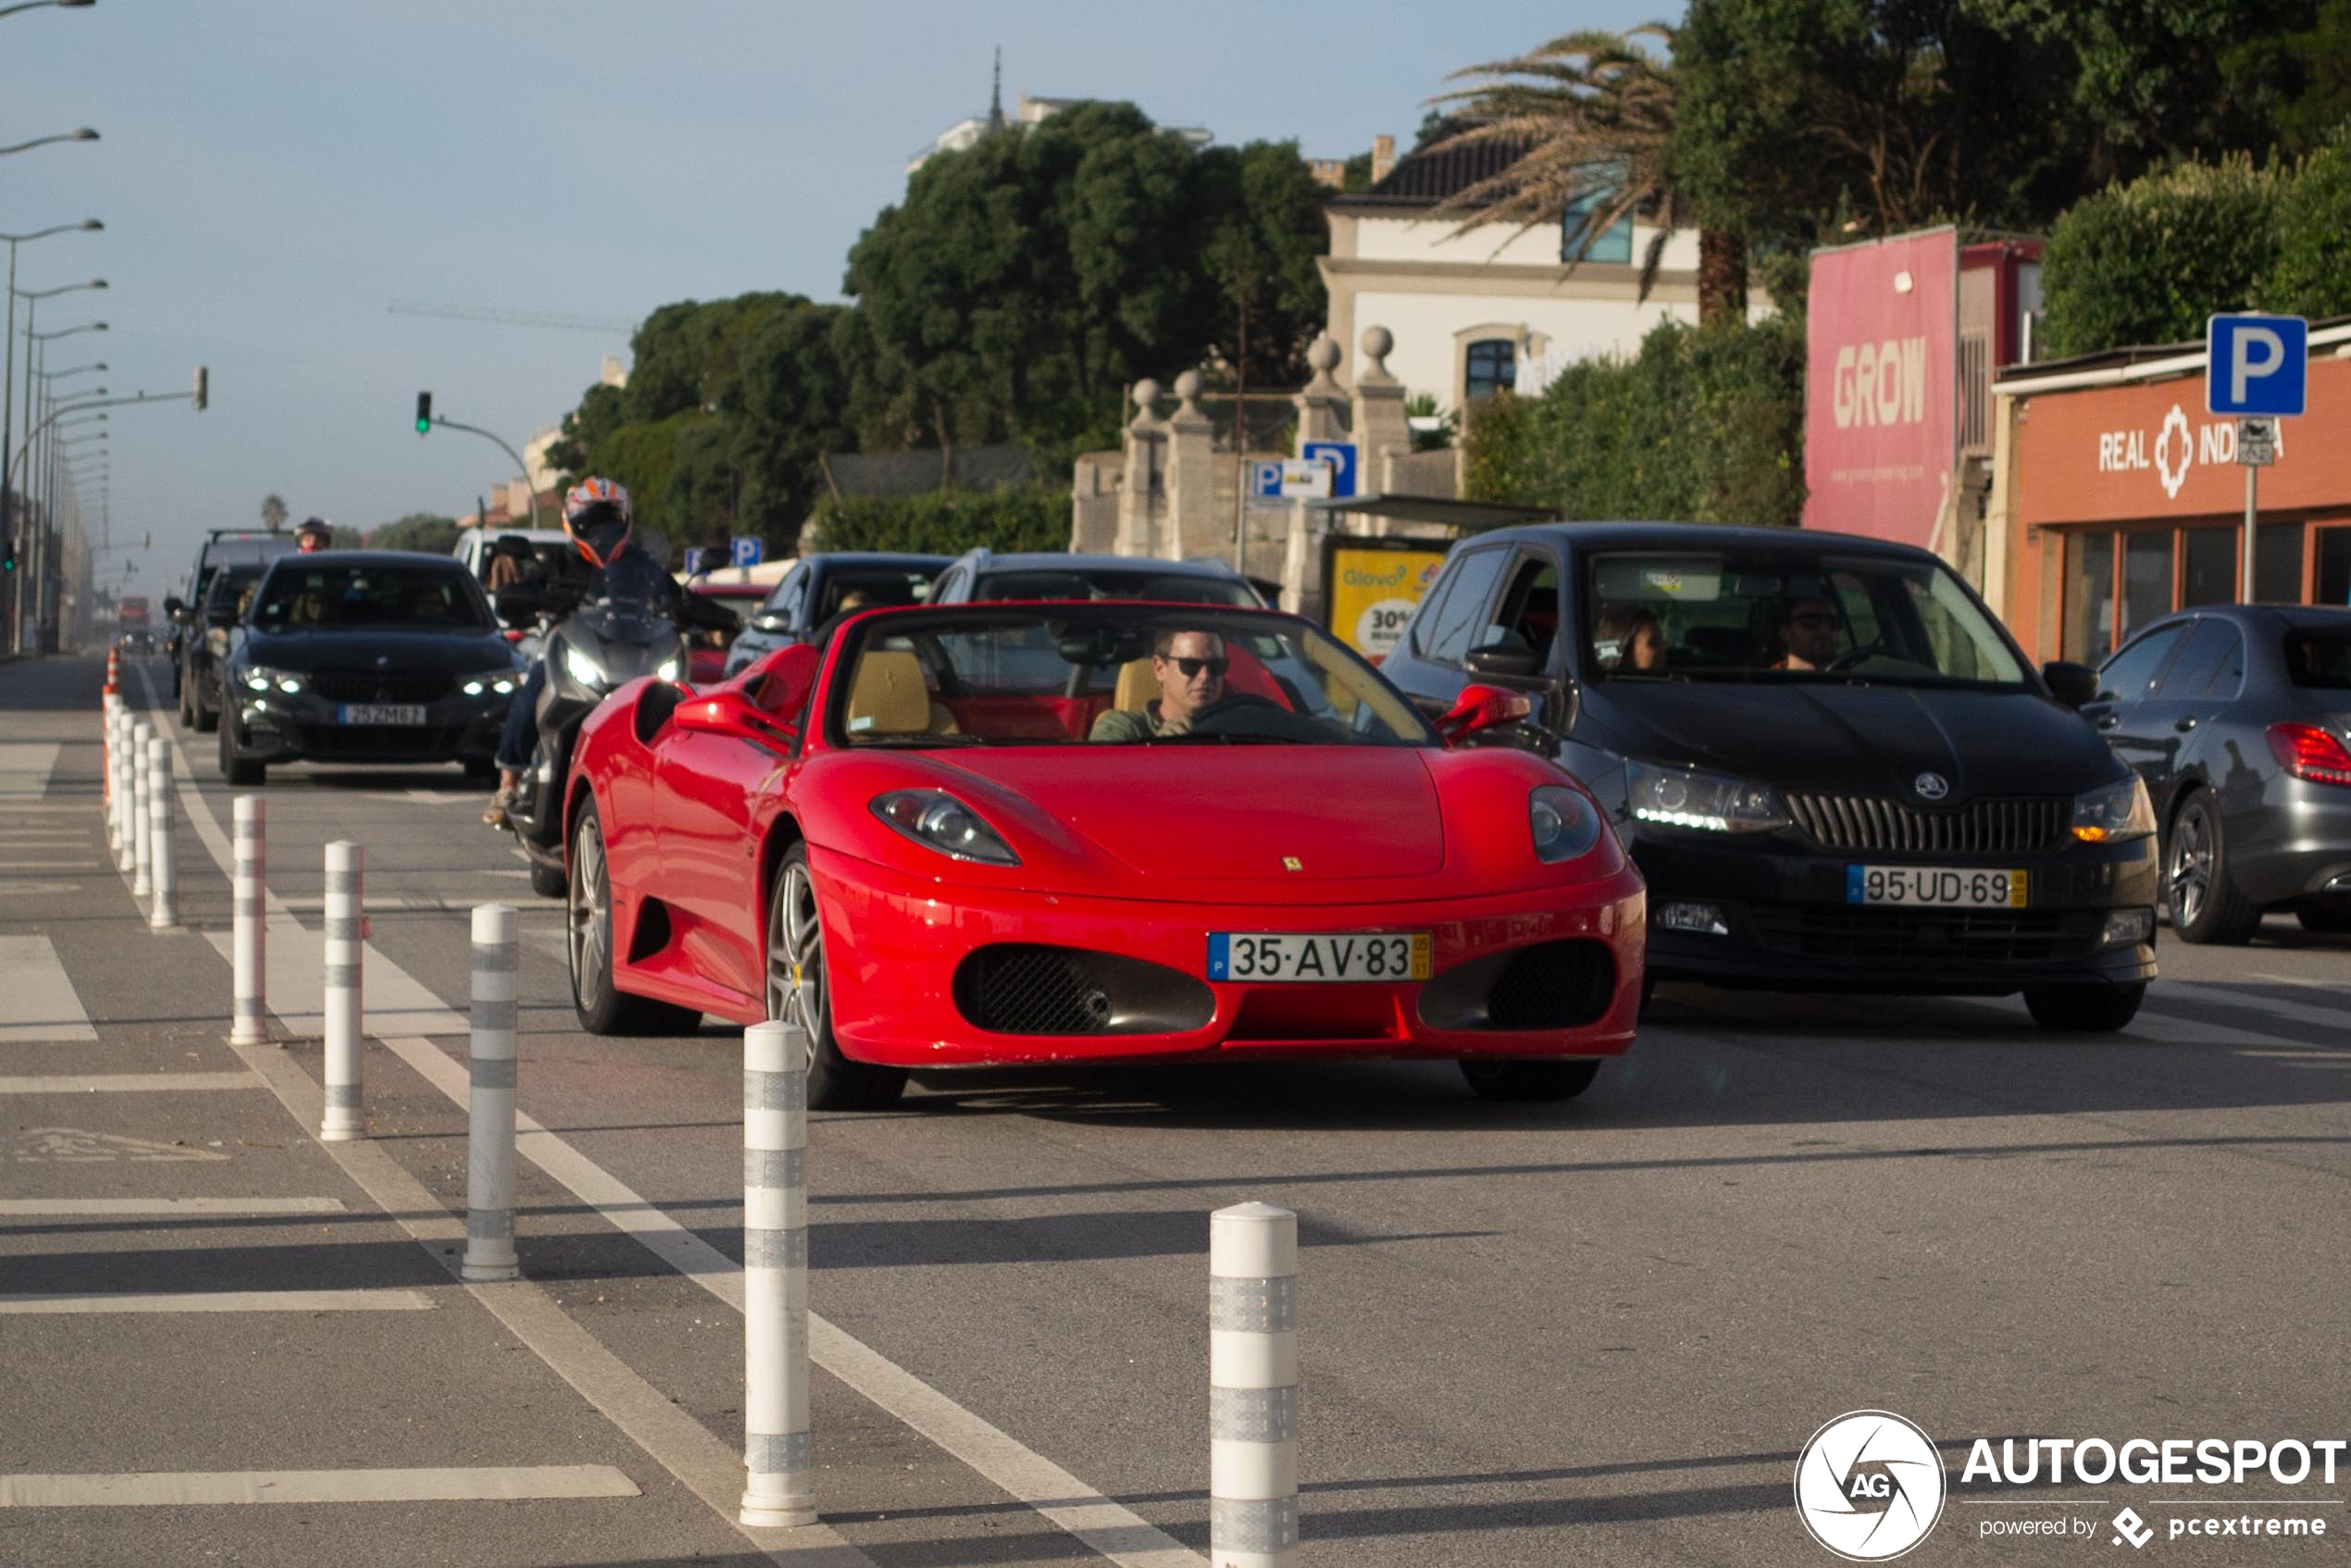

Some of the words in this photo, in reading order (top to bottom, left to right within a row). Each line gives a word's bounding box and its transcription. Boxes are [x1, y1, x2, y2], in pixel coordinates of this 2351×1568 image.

[2231, 327, 2284, 404] P
[1834, 336, 1926, 429] GROW
[2099, 429, 2150, 472] REAL
[1258, 464, 1281, 496] P
[738, 540, 756, 566] P
[1343, 566, 1401, 588] Glovo
[1413, 939, 1429, 951] 05
[1214, 962, 1223, 972] P
